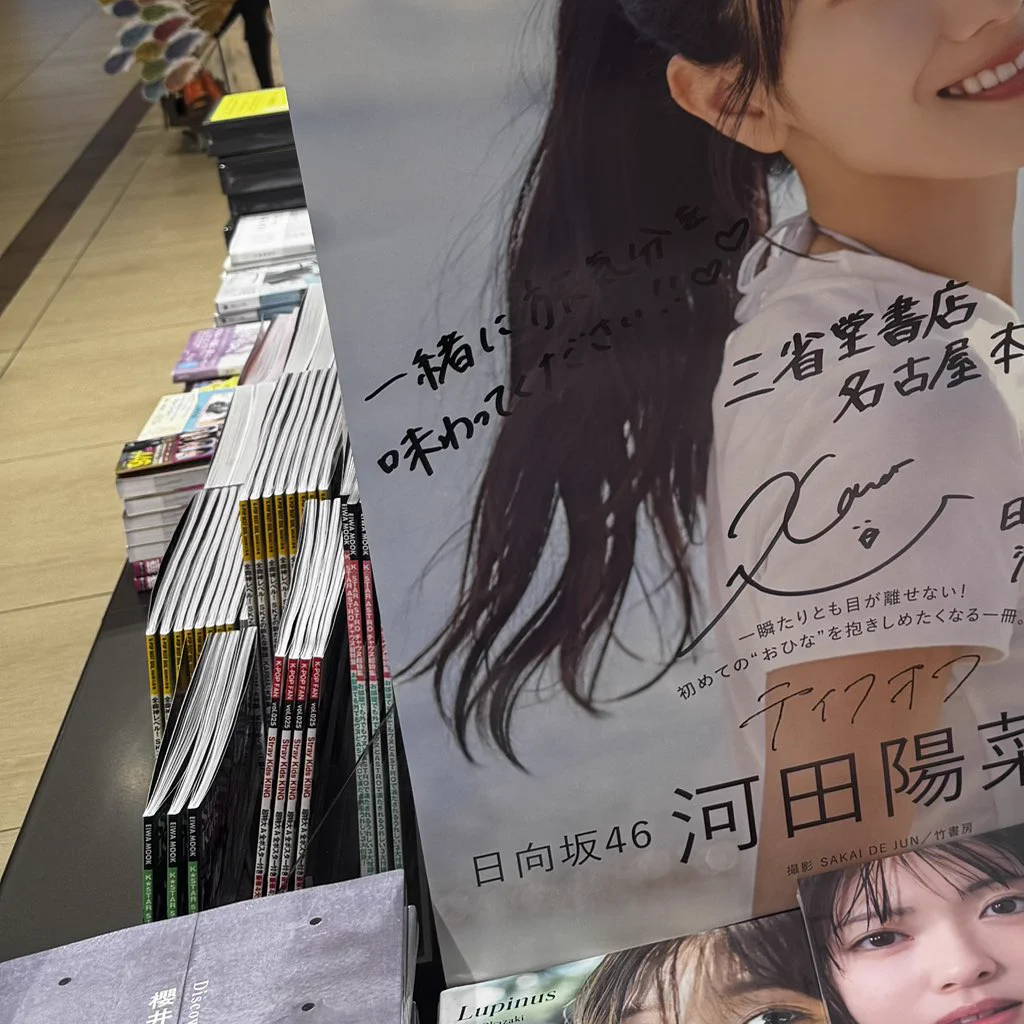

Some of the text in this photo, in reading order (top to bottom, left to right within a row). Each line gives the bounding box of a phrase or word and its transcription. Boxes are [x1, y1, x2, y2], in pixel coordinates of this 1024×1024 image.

[724, 279, 981, 407] 三省堂書店
[300, 663, 308, 685] K-POP
[298, 686, 306, 700] FAN
[263, 661, 282, 798] K-POP FAN vol.025 Stray Kids KING
[277, 663, 297, 800] K-POP FAN vol.025 Stray Kids KING
[303, 661, 320, 798] K-POP FAN vol.025 Stray Kids KING
[292, 739, 301, 758] Stray
[291, 762, 299, 778] Kids
[289, 780, 298, 800] KING
[472, 821, 654, 888] 日向坂46
[820, 849, 863, 867] SAKAI
[869, 842, 887, 855] DE
[457, 990, 556, 1022] Lupinus
[482, 1015, 524, 1024] kazaki
